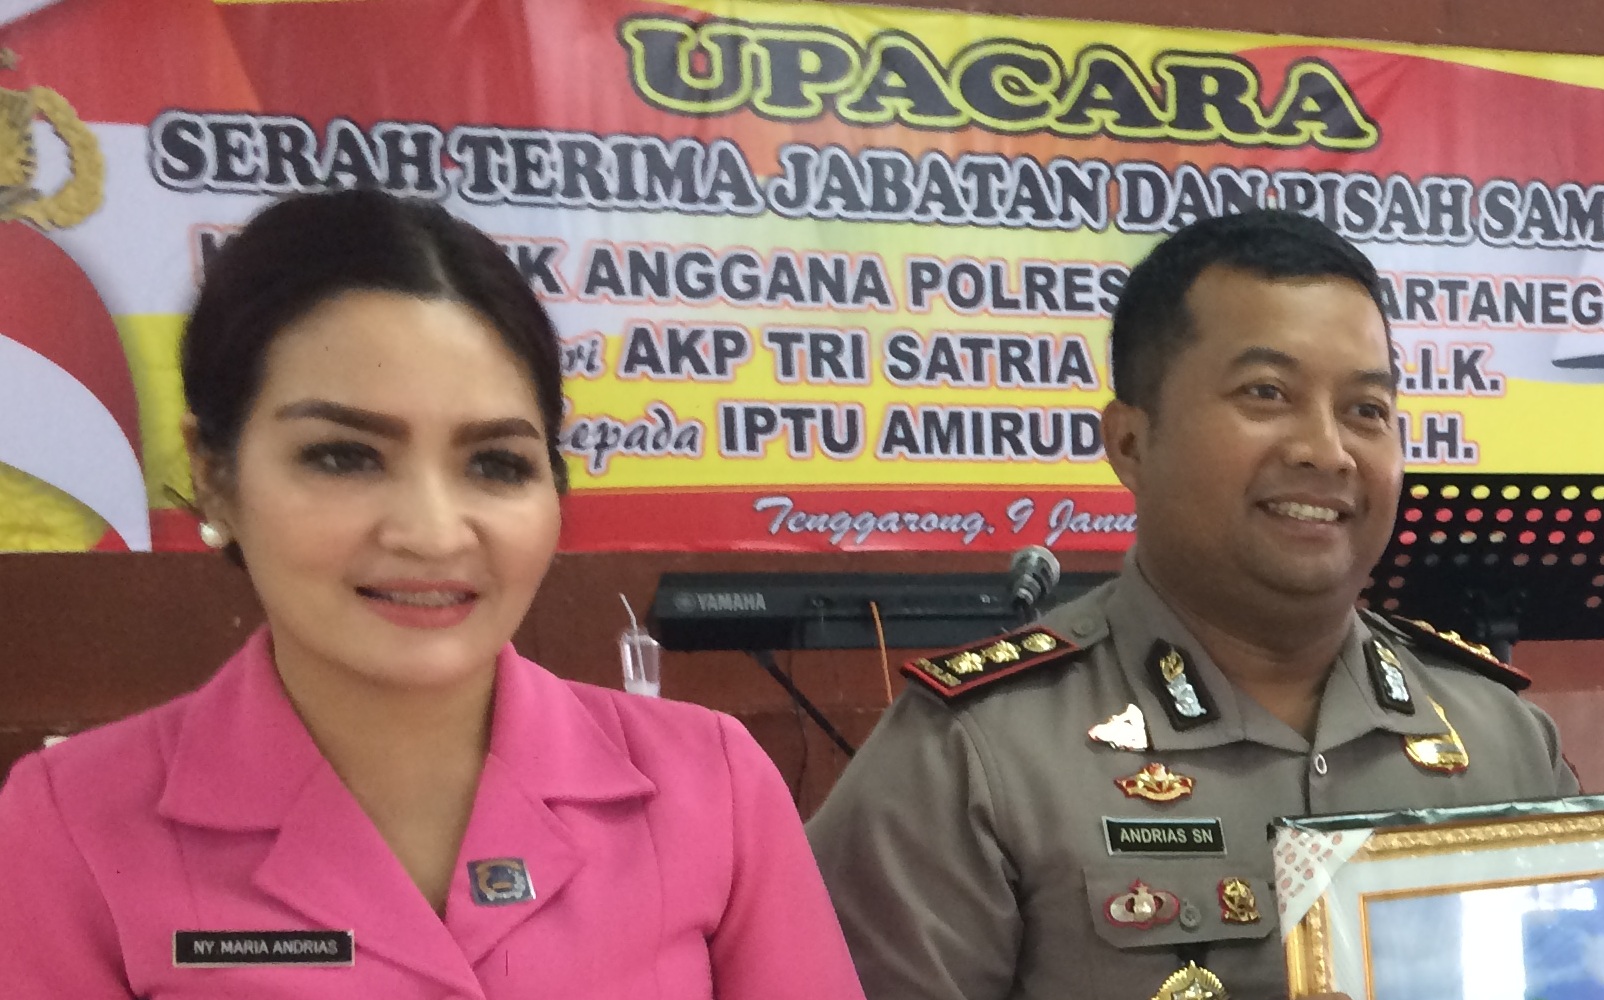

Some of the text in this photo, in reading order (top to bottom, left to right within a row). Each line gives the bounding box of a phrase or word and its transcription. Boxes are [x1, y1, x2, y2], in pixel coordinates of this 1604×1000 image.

[622, 18, 1378, 149] UPACARA
[152, 113, 449, 198] SERAH
[451, 124, 763, 211] TERIMA
[768, 144, 1107, 231] JABATAN
[1117, 164, 1264, 230] DAN
[1274, 170, 1476, 243] PISAH
[583, 247, 891, 307] ANGGANA
[909, 259, 1134, 316] POLRES
[623, 325, 748, 379] AKP
[768, 332, 864, 378] TRI
[887, 335, 1095, 385] SATRIA
[560, 407, 702, 472] epada
[723, 404, 857, 456] IPTU
[883, 409, 1103, 459] AMIRUD
[1006, 497, 1034, 534] 9
[1044, 498, 1137, 547] Janu
[696, 592, 767, 611] YAMAHA
[1120, 827, 1214, 844] ANDRIAS SN
[220, 939, 270, 955] MARIA
[272, 939, 339, 956] ANDRIAS
